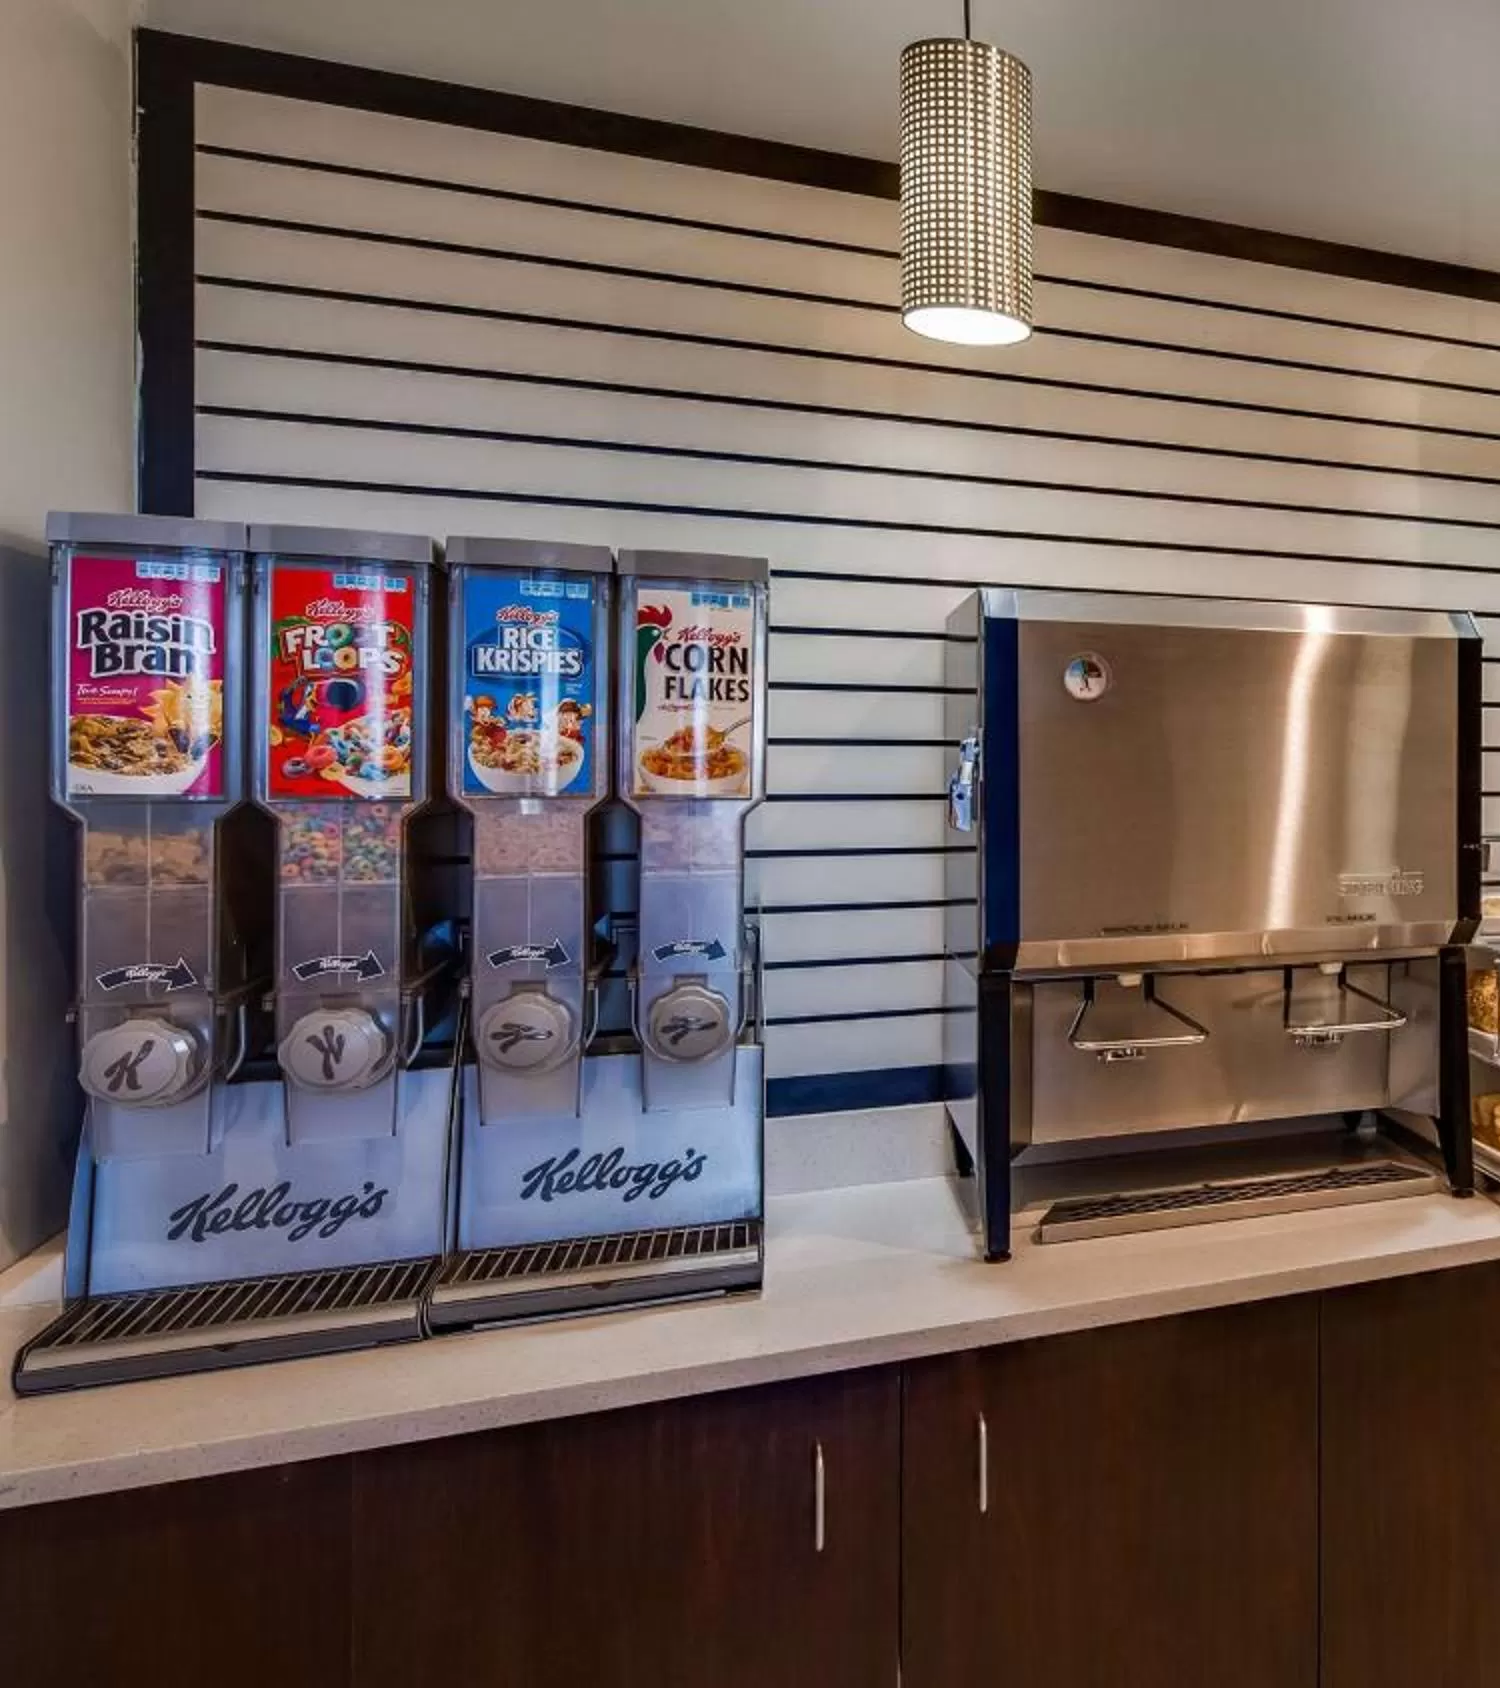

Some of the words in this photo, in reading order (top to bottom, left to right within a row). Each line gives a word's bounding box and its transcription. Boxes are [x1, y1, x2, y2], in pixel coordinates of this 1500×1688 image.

[107, 588, 182, 612] Kellogg's
[79, 609, 213, 652] Raisin
[502, 626, 553, 649] RICE
[92, 641, 198, 677] Bran
[302, 647, 403, 673] LOOPS
[477, 646, 581, 675] KRISPIES
[665, 643, 748, 675] CORN
[665, 675, 750, 702] FLAKES
[519, 1147, 708, 1202] Kellogg's
[166, 1181, 389, 1243] Kellogg's
